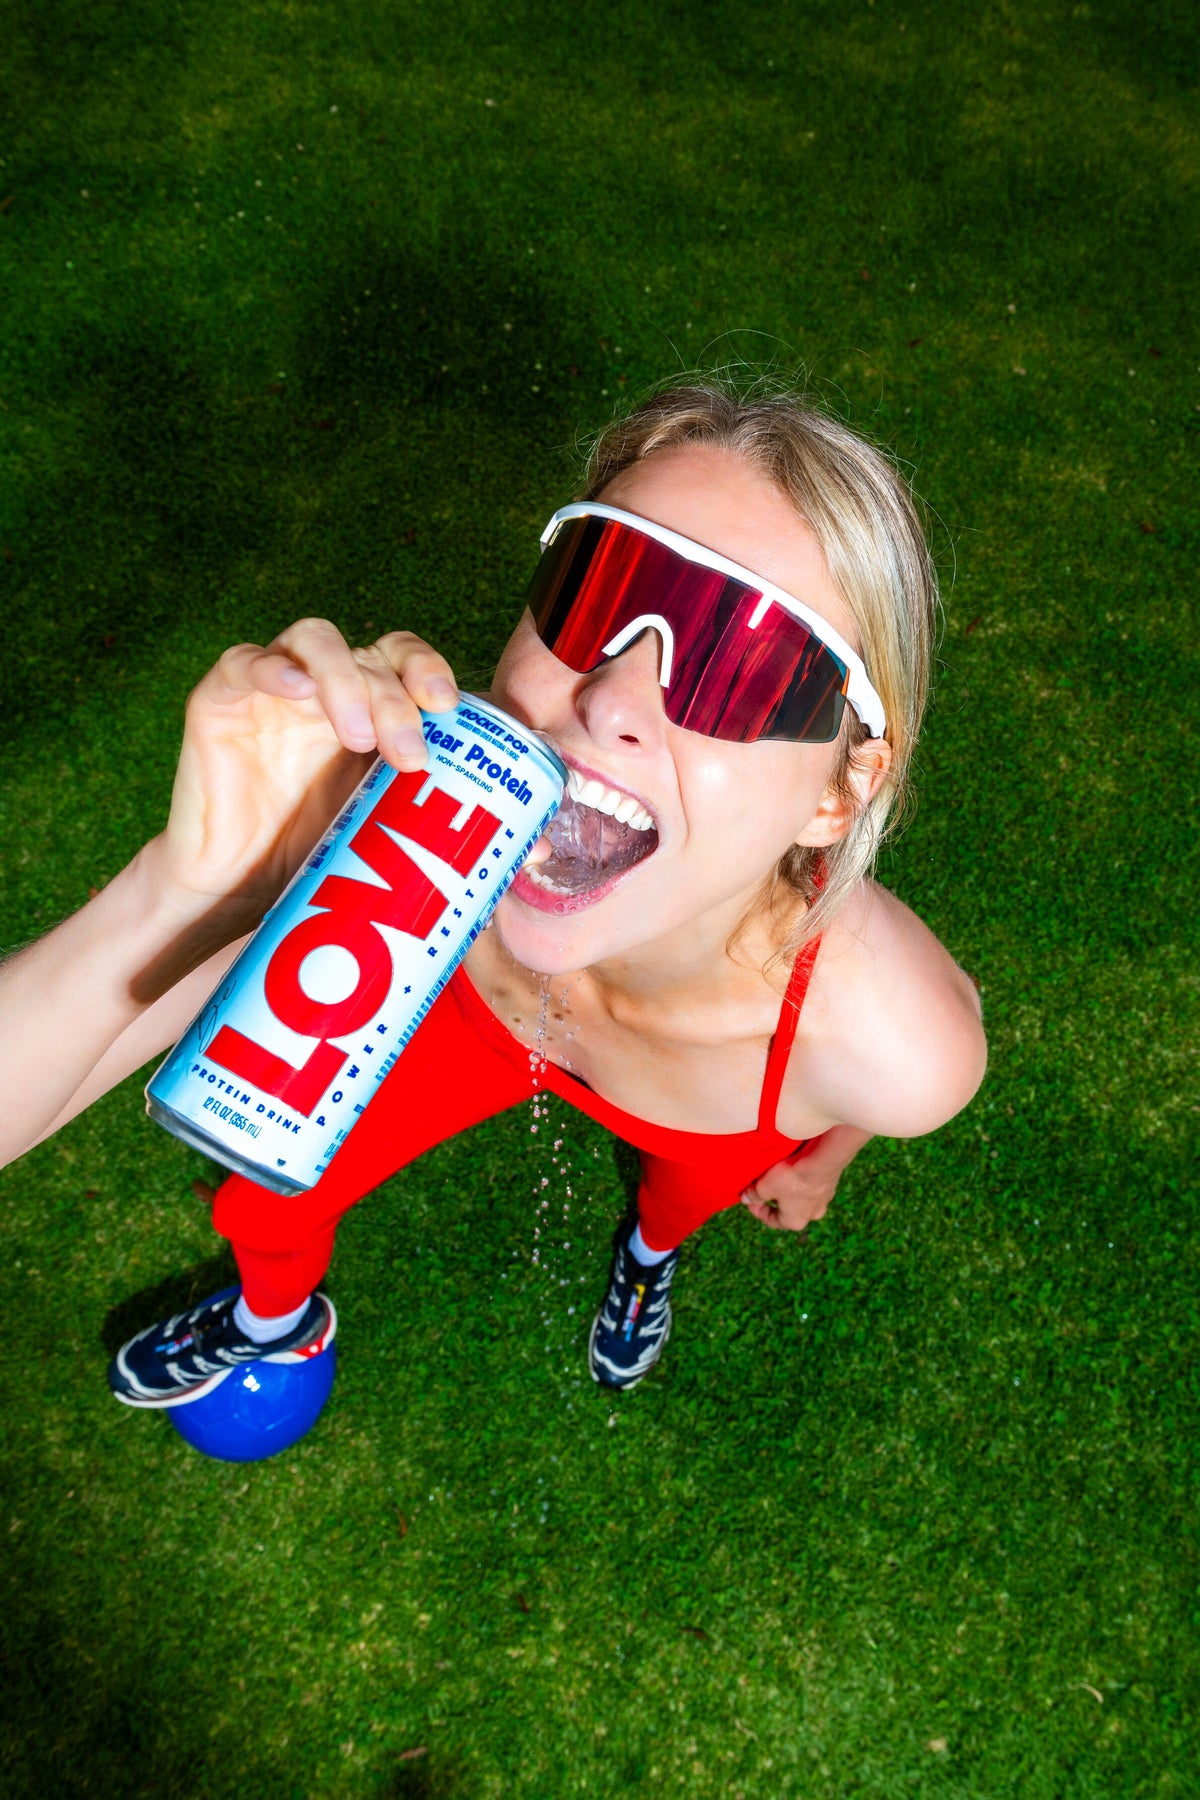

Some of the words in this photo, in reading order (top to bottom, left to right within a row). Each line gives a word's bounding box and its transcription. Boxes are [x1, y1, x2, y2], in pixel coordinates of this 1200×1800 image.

[458, 708, 505, 736] ROCKET
[504, 733, 529, 754] POP
[436, 754, 493, 793] NON-SPARKLING
[464, 744, 533, 806] Protein
[203, 769, 503, 1118] LOVE
[316, 1023, 389, 1127] POWER
[427, 828, 515, 957] RESTORE
[191, 1064, 251, 1105] PROTEIN
[256, 1103, 302, 1134] DRINK
[202, 1096, 215, 1110] 12
[210, 1100, 223, 1115] FL
[218, 1105, 233, 1121] OZ
[228, 1111, 249, 1131] (355
